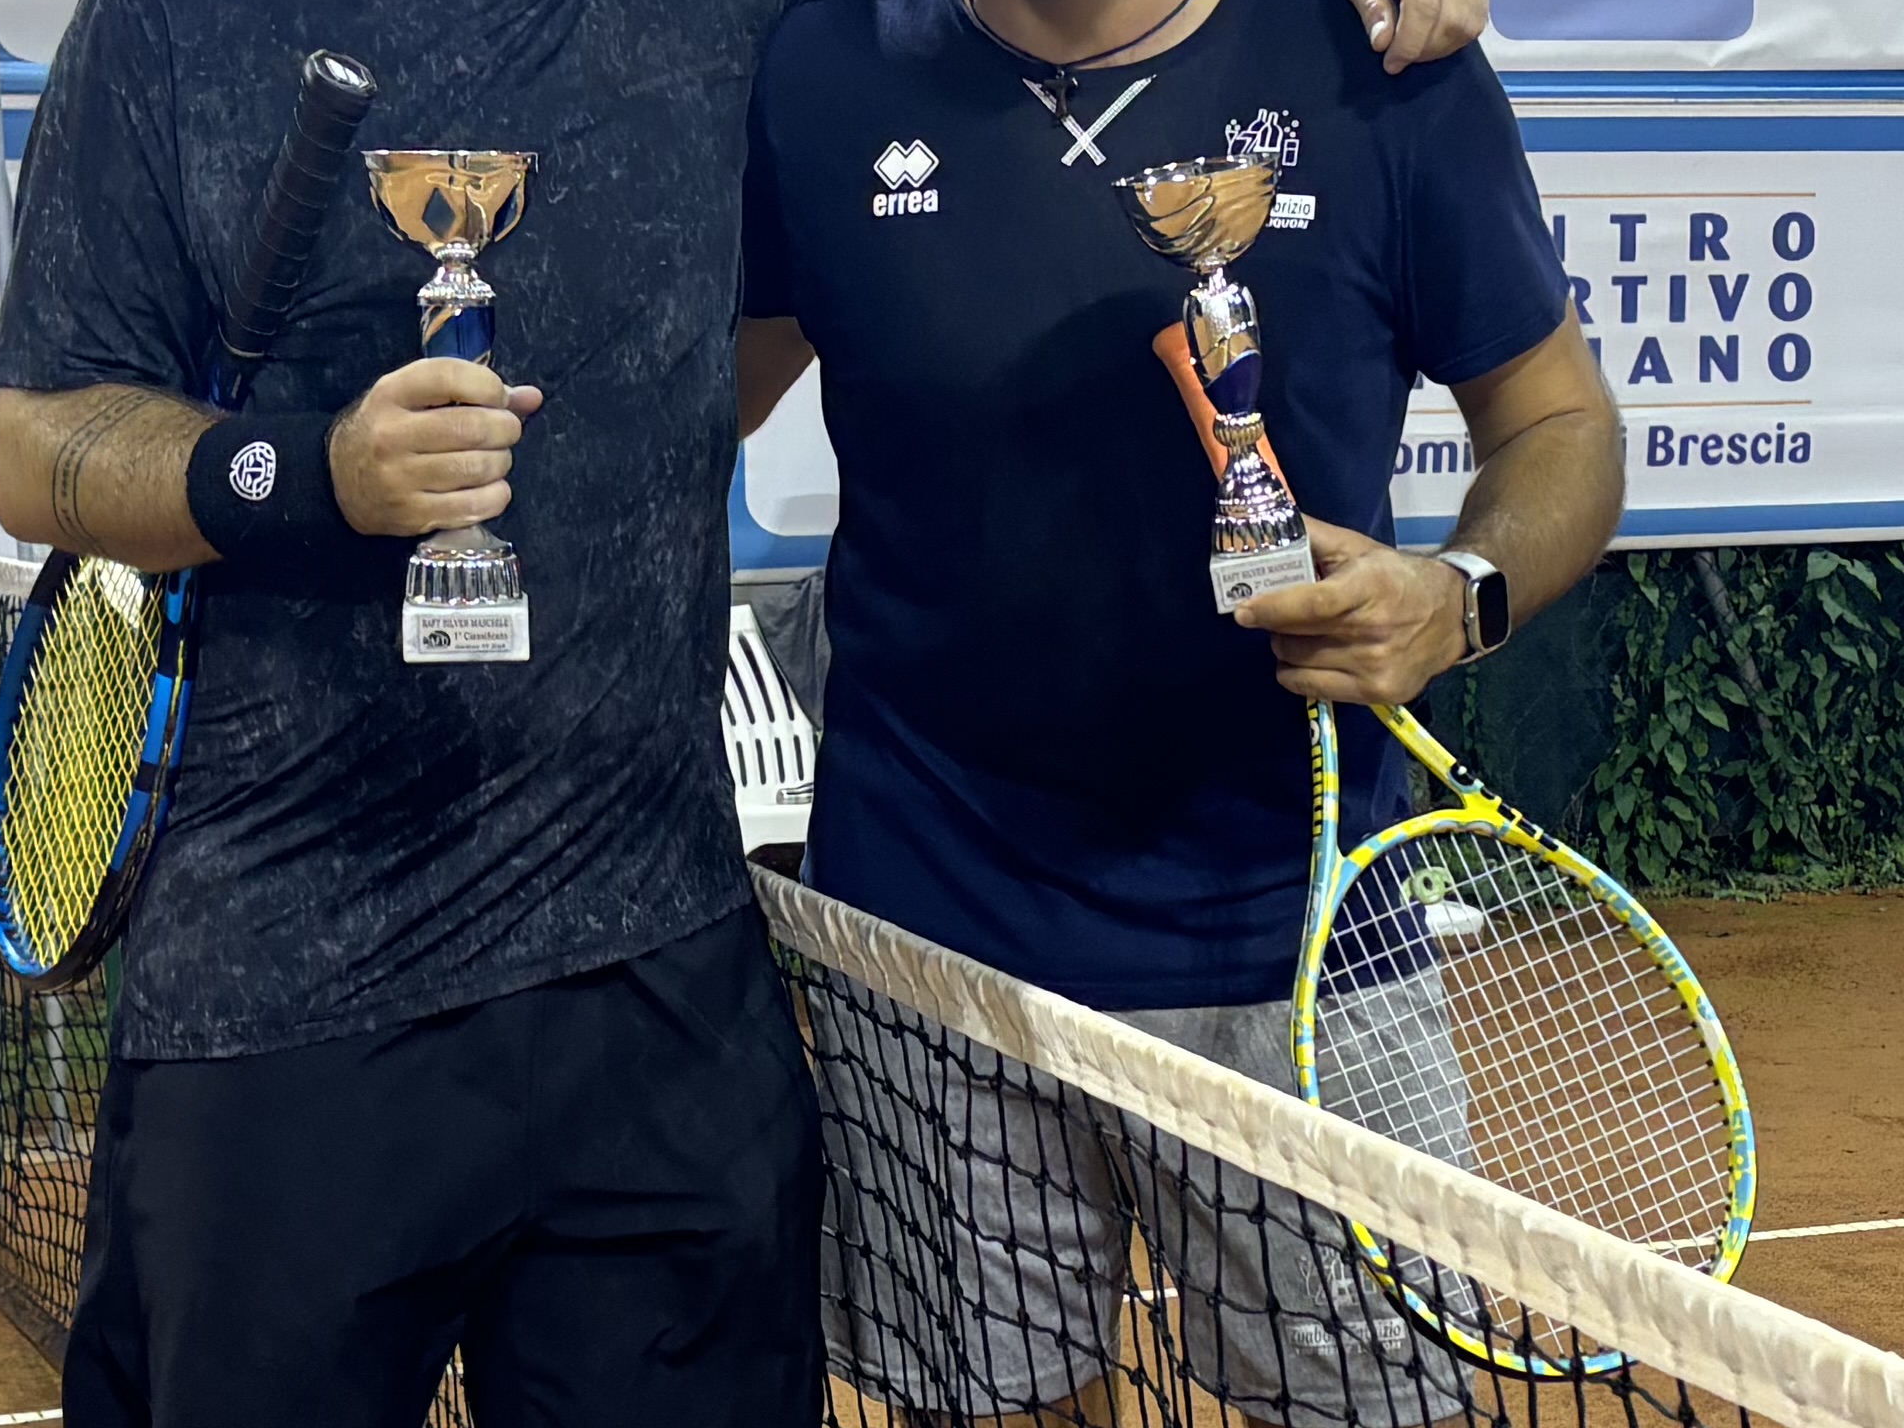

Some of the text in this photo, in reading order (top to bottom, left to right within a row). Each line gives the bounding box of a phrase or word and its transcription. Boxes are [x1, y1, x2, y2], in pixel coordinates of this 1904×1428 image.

[872, 189, 939, 217] errea
[1569, 272, 1813, 324] RTIVO
[1646, 422, 1811, 467] Brescia
